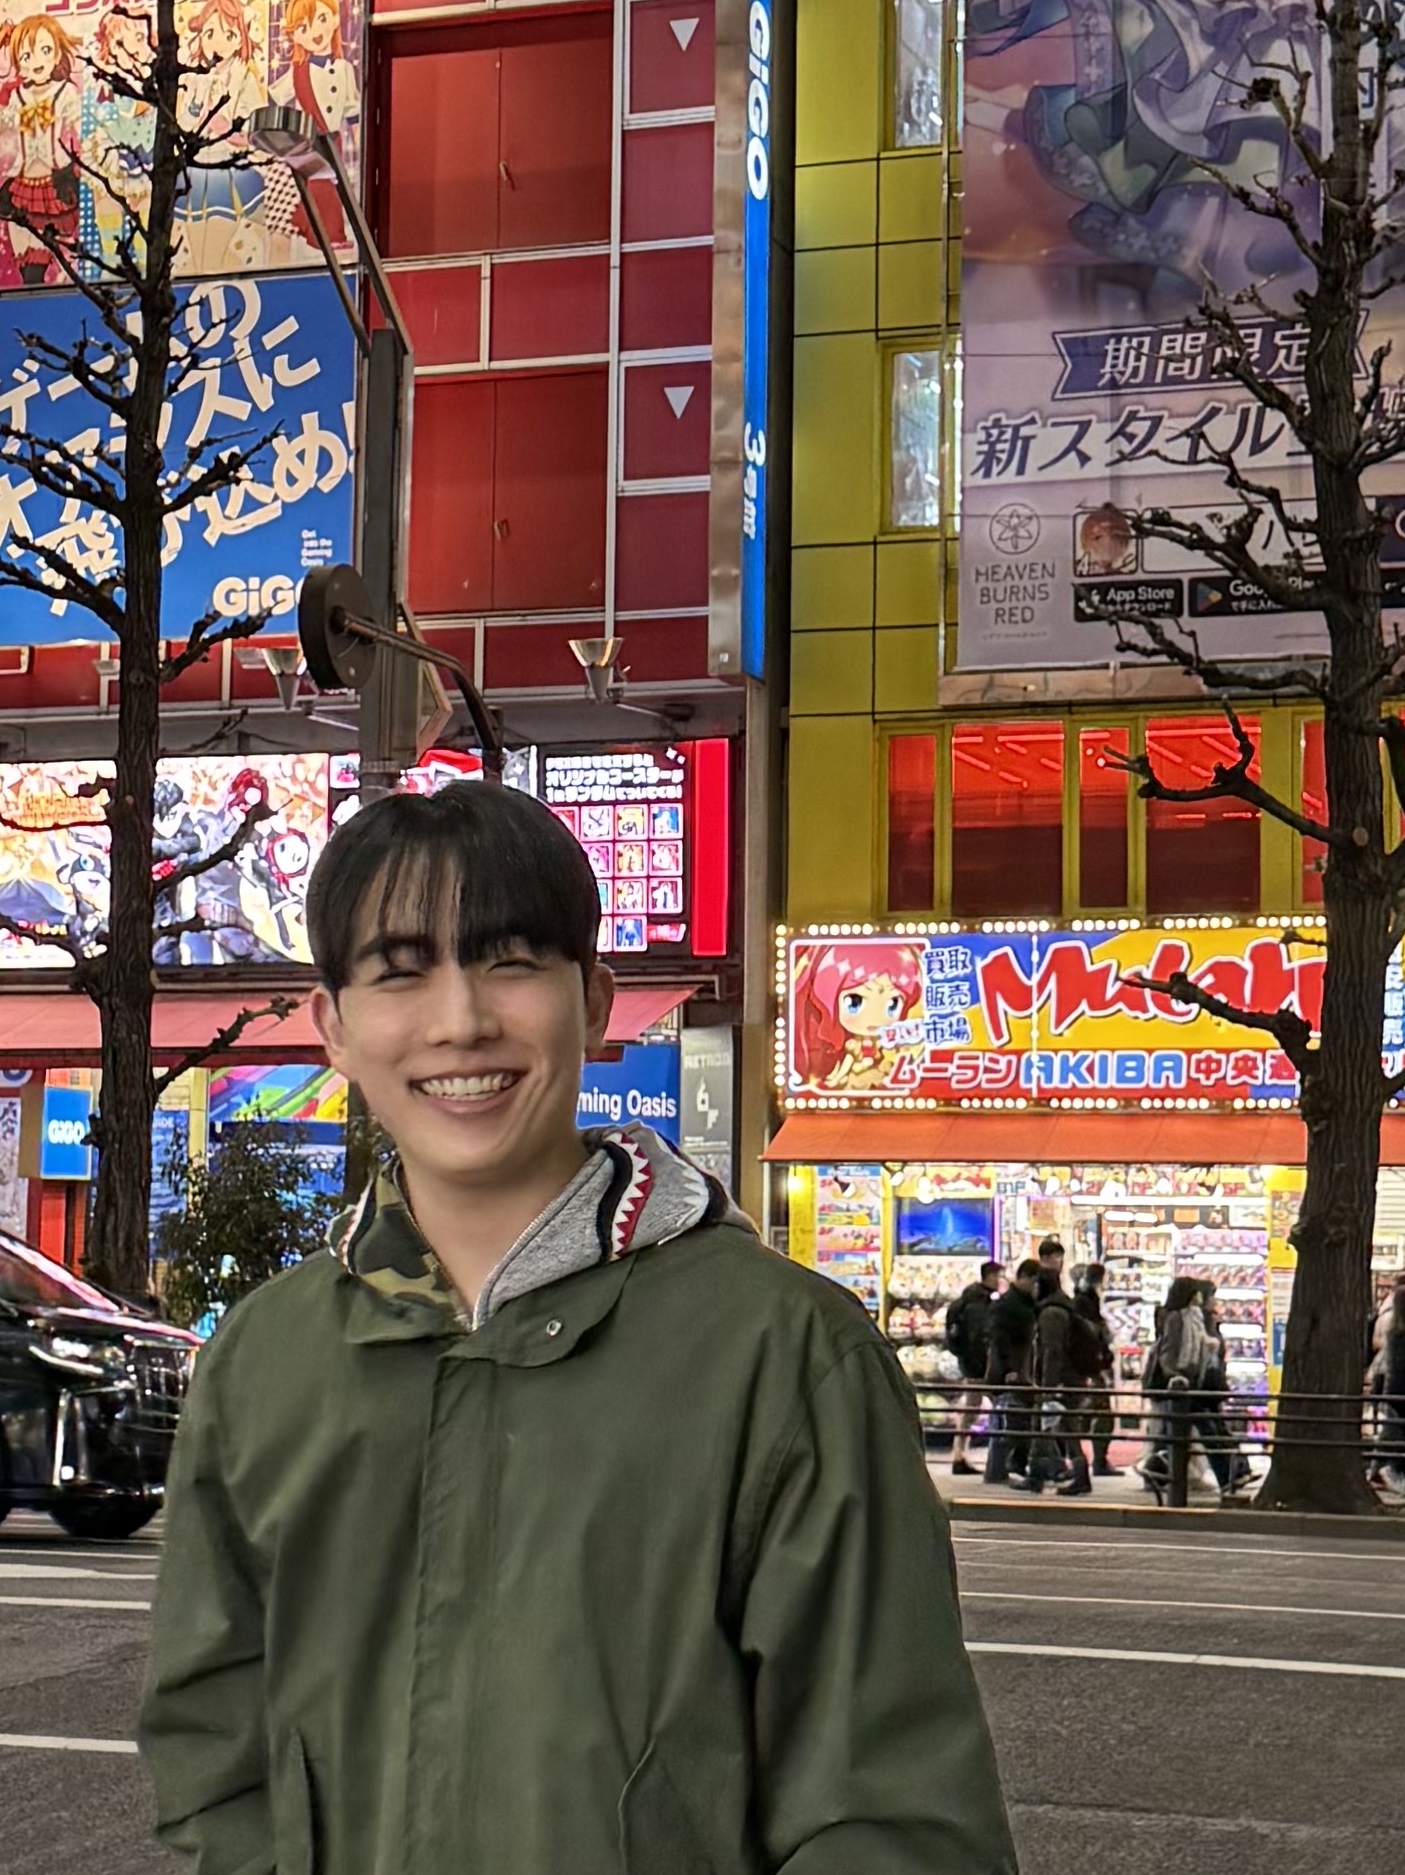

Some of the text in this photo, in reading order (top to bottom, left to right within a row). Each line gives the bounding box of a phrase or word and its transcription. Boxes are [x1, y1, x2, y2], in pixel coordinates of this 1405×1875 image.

[975, 562, 1056, 584] HEAVEN
[212, 574, 302, 617] GiG
[980, 583, 1050, 604] BURNS
[1106, 585, 1176, 603] App Store
[993, 605, 1035, 625] RED
[924, 947, 971, 978] 買取
[924, 983, 970, 1010] 販売
[924, 1017, 971, 1044] 市場
[884, 1052, 1016, 1090] ムーラン
[1023, 1051, 1184, 1089] AKIBA
[626, 1088, 677, 1118] Oasis
